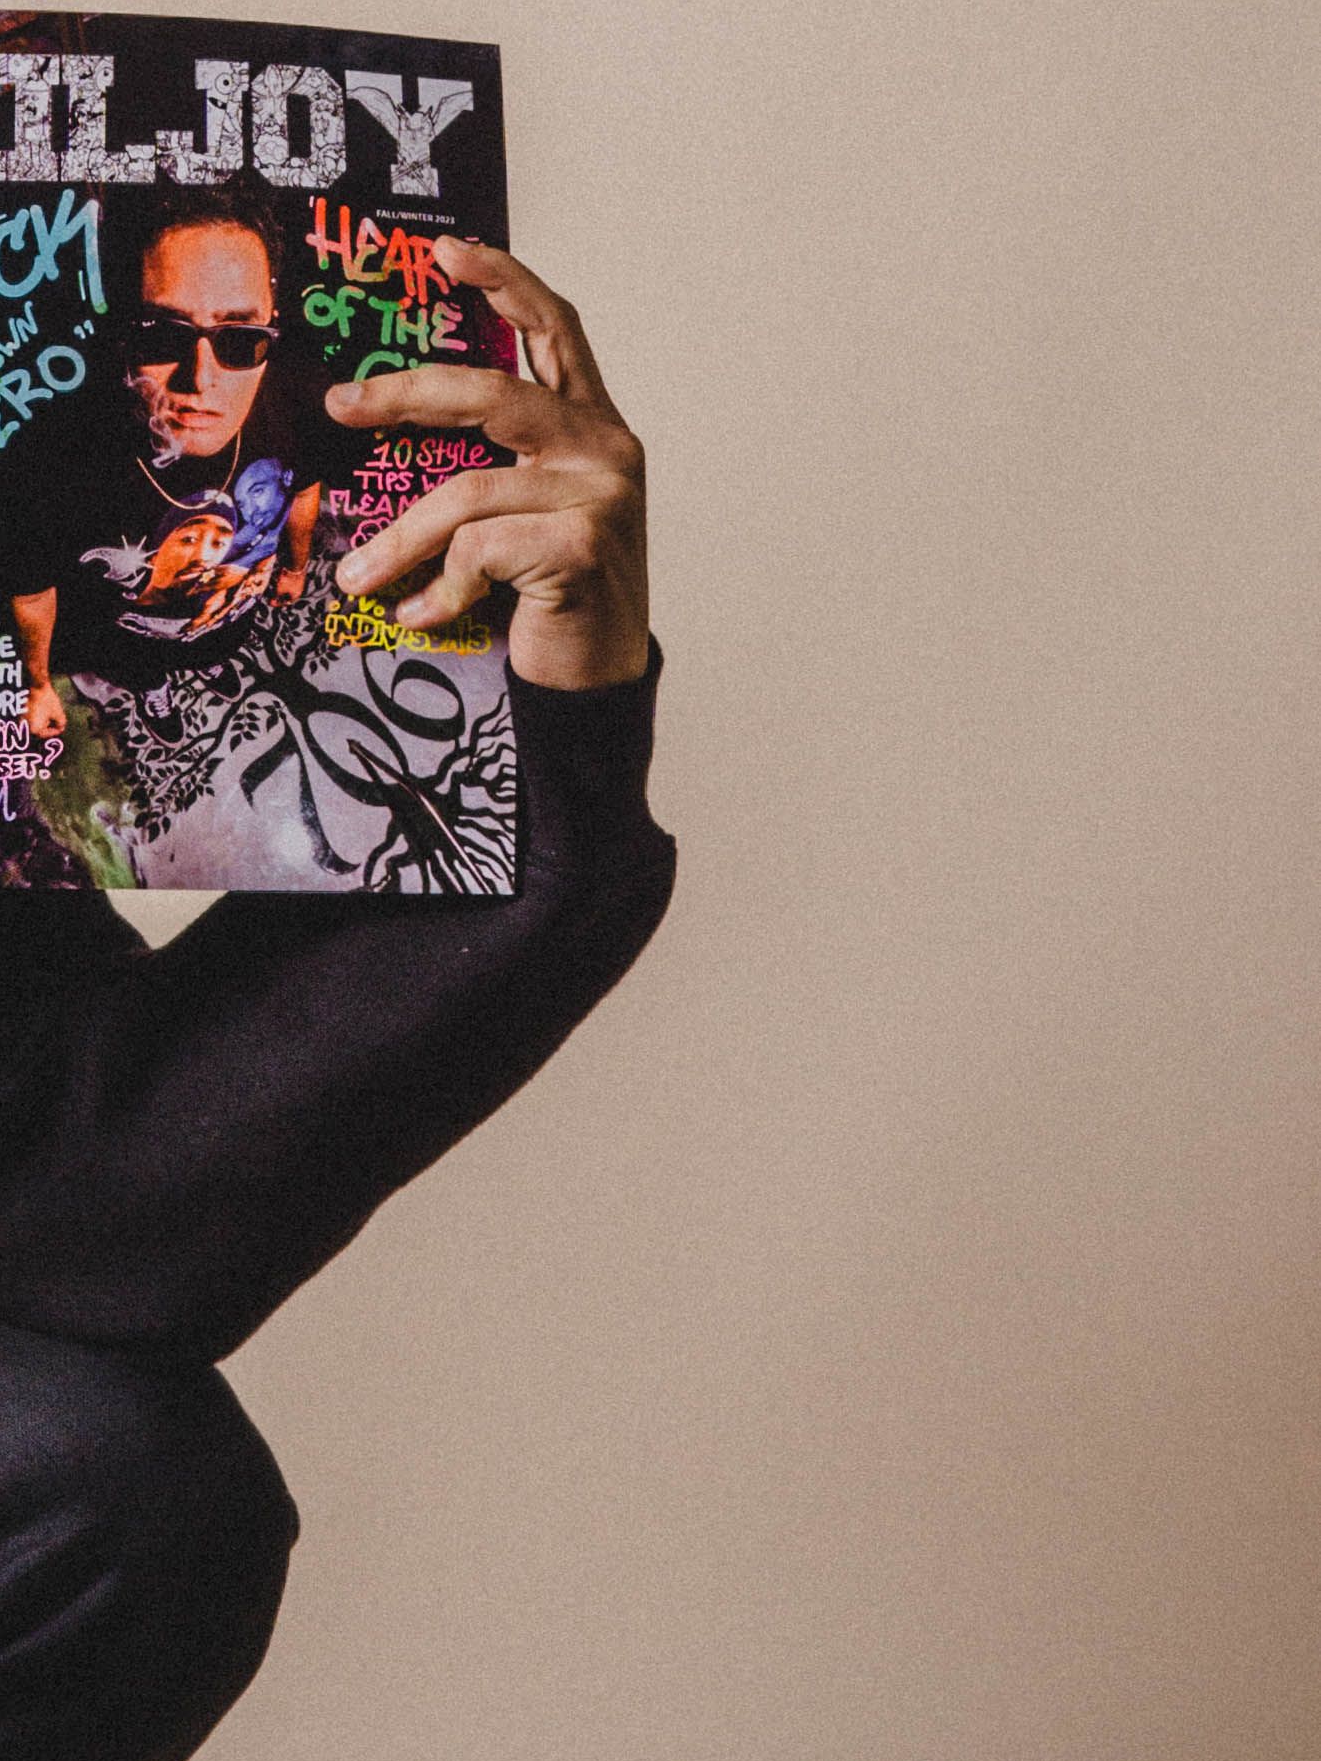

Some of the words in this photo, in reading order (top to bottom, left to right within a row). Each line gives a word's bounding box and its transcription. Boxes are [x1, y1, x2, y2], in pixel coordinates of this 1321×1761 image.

[305, 196, 459, 306] HEAR
[368, 296, 469, 354] THE
[365, 437, 413, 470] 10
[416, 437, 494, 474] Style
[353, 470, 415, 493] TIPS
[328, 489, 395, 518] FLEA
